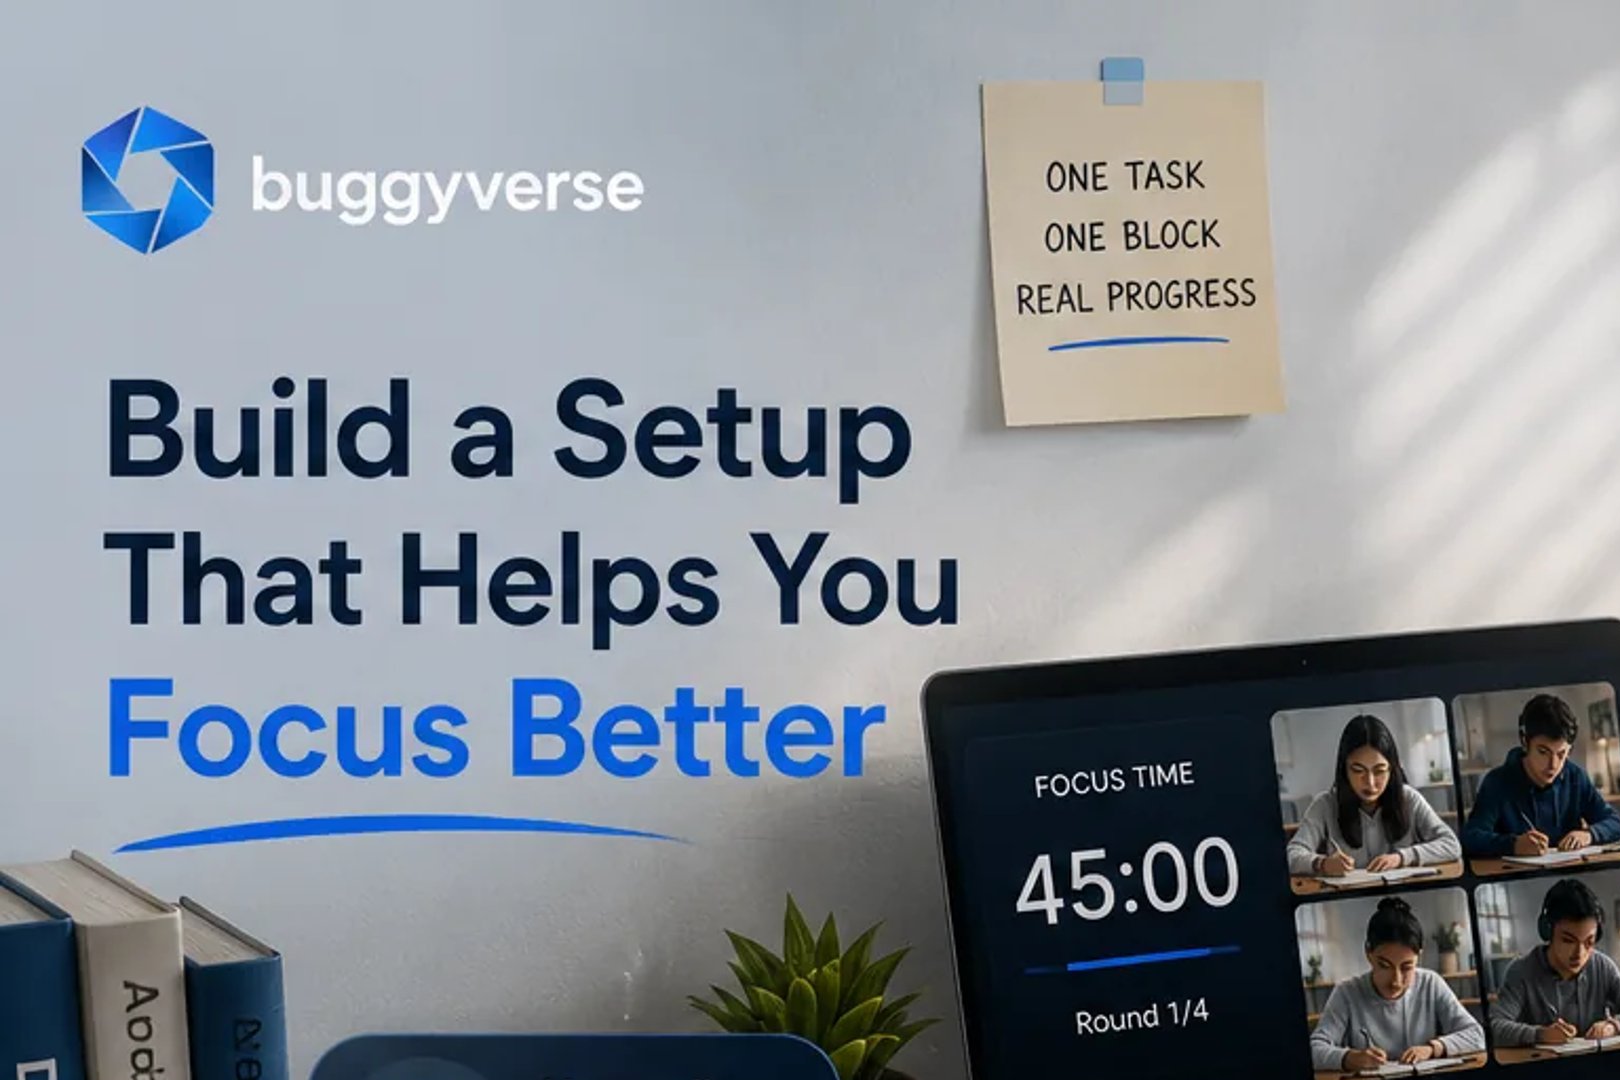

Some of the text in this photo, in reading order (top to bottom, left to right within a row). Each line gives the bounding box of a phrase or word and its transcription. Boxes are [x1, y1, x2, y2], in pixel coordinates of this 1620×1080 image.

[1047, 160, 1205, 192] ONE TASK
[1045, 219, 1220, 253] ONE BLOCK
[1017, 278, 1256, 314] REAL PROGRESS
[1035, 761, 1195, 798] FOCUS TIME
[1017, 837, 1238, 924] 45:00
[1077, 998, 1209, 1035] Round 1/4
